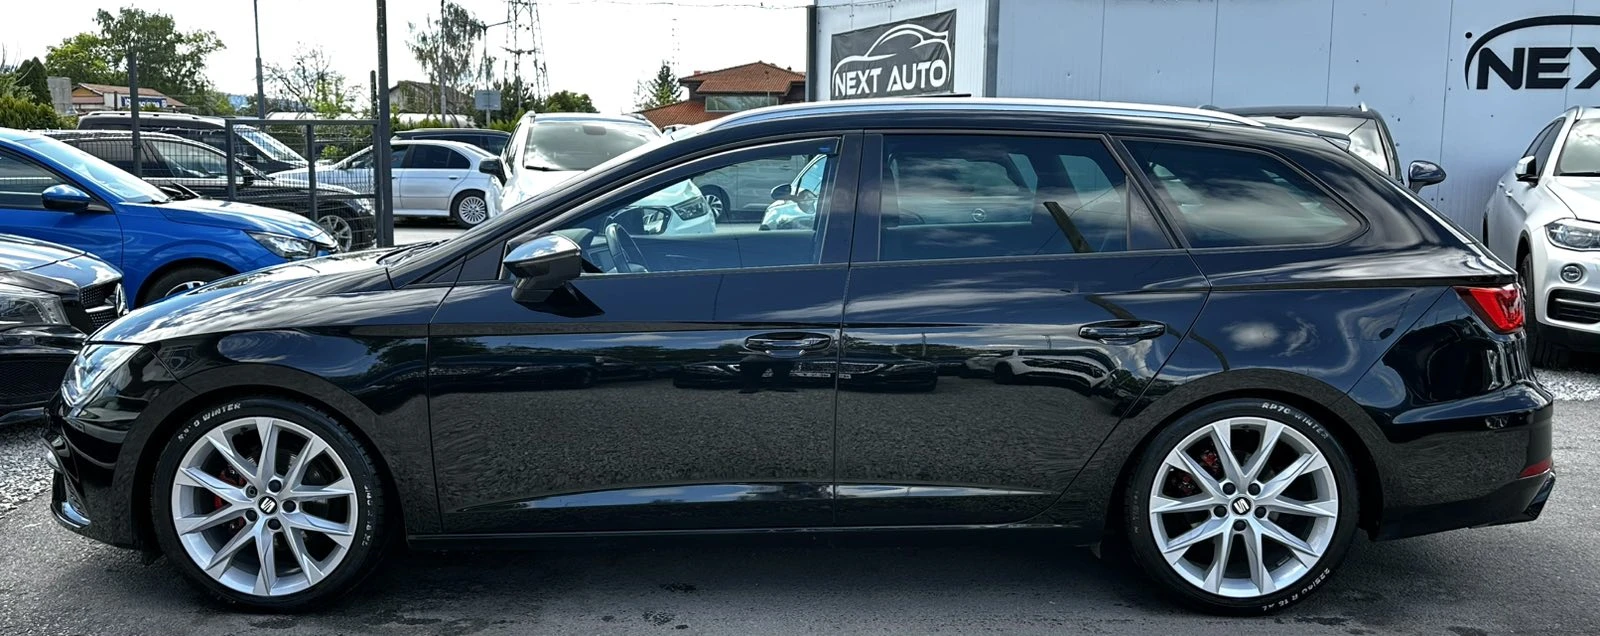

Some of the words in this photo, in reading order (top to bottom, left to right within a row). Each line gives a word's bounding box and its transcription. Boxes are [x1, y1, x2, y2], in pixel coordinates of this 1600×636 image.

[835, 67, 882, 97] NEXT
[886, 59, 947, 92] AUTO
[202, 402, 241, 421] WINTER
